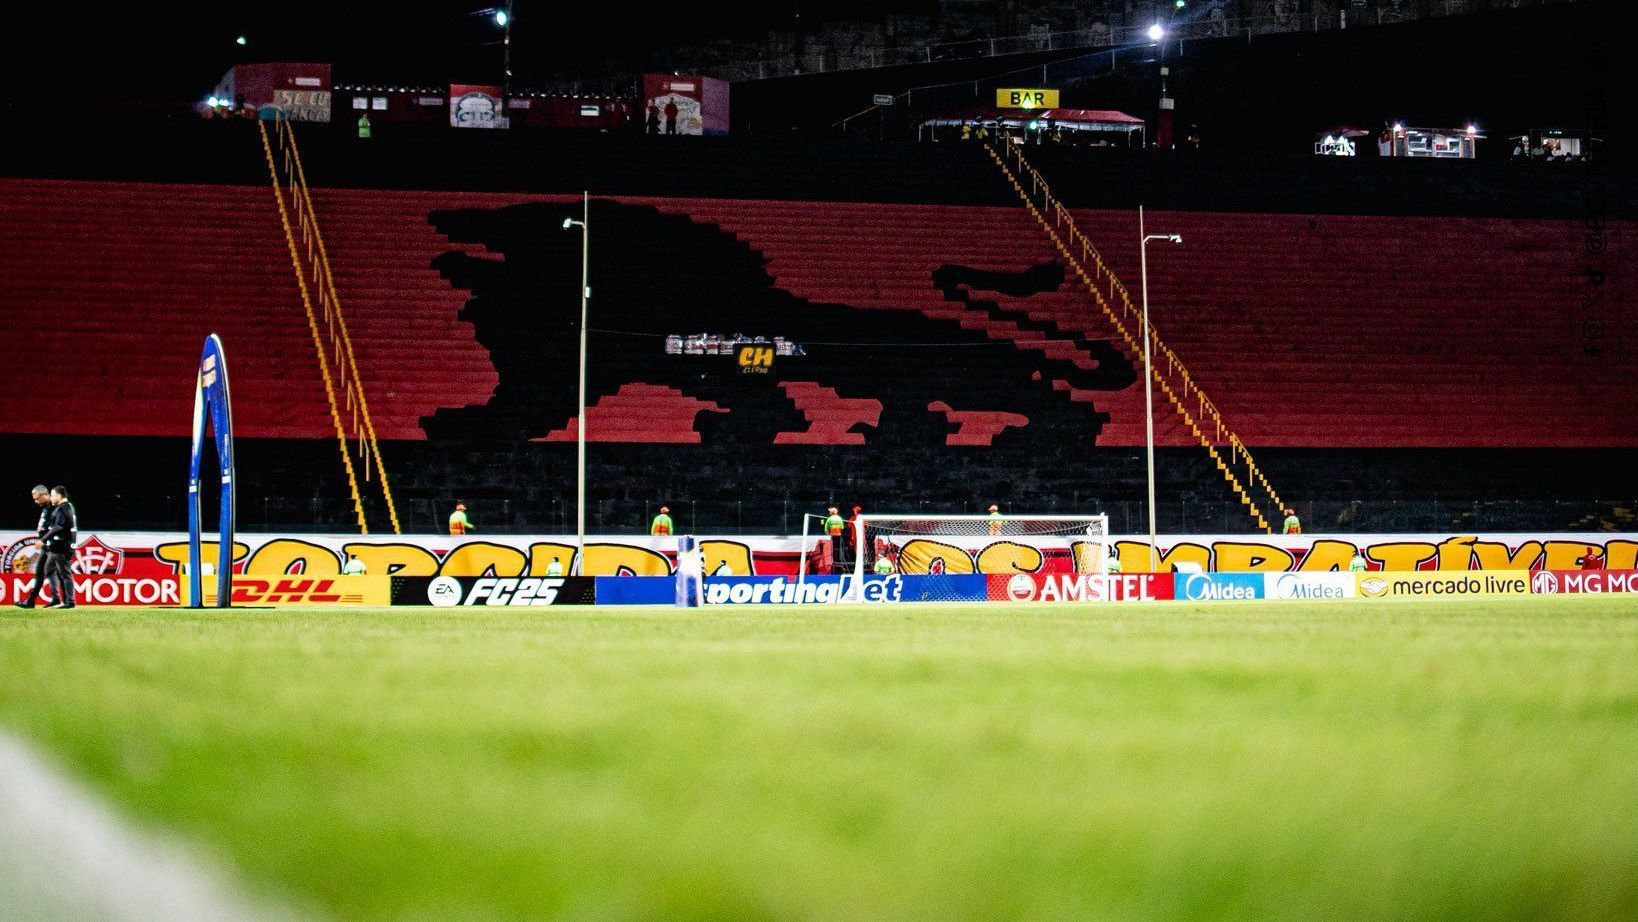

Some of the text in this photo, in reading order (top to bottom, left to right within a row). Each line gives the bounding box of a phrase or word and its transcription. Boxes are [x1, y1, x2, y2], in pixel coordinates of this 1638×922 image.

[1010, 92, 1045, 106] BAR
[738, 346, 774, 368] CH
[74, 578, 180, 604] MOTOR
[231, 579, 340, 603] DHL
[1201, 577, 1256, 600] Midea
[1291, 578, 1344, 599] Midea
[1393, 576, 1526, 595] mercado livre
[1564, 573, 1602, 594] MG
